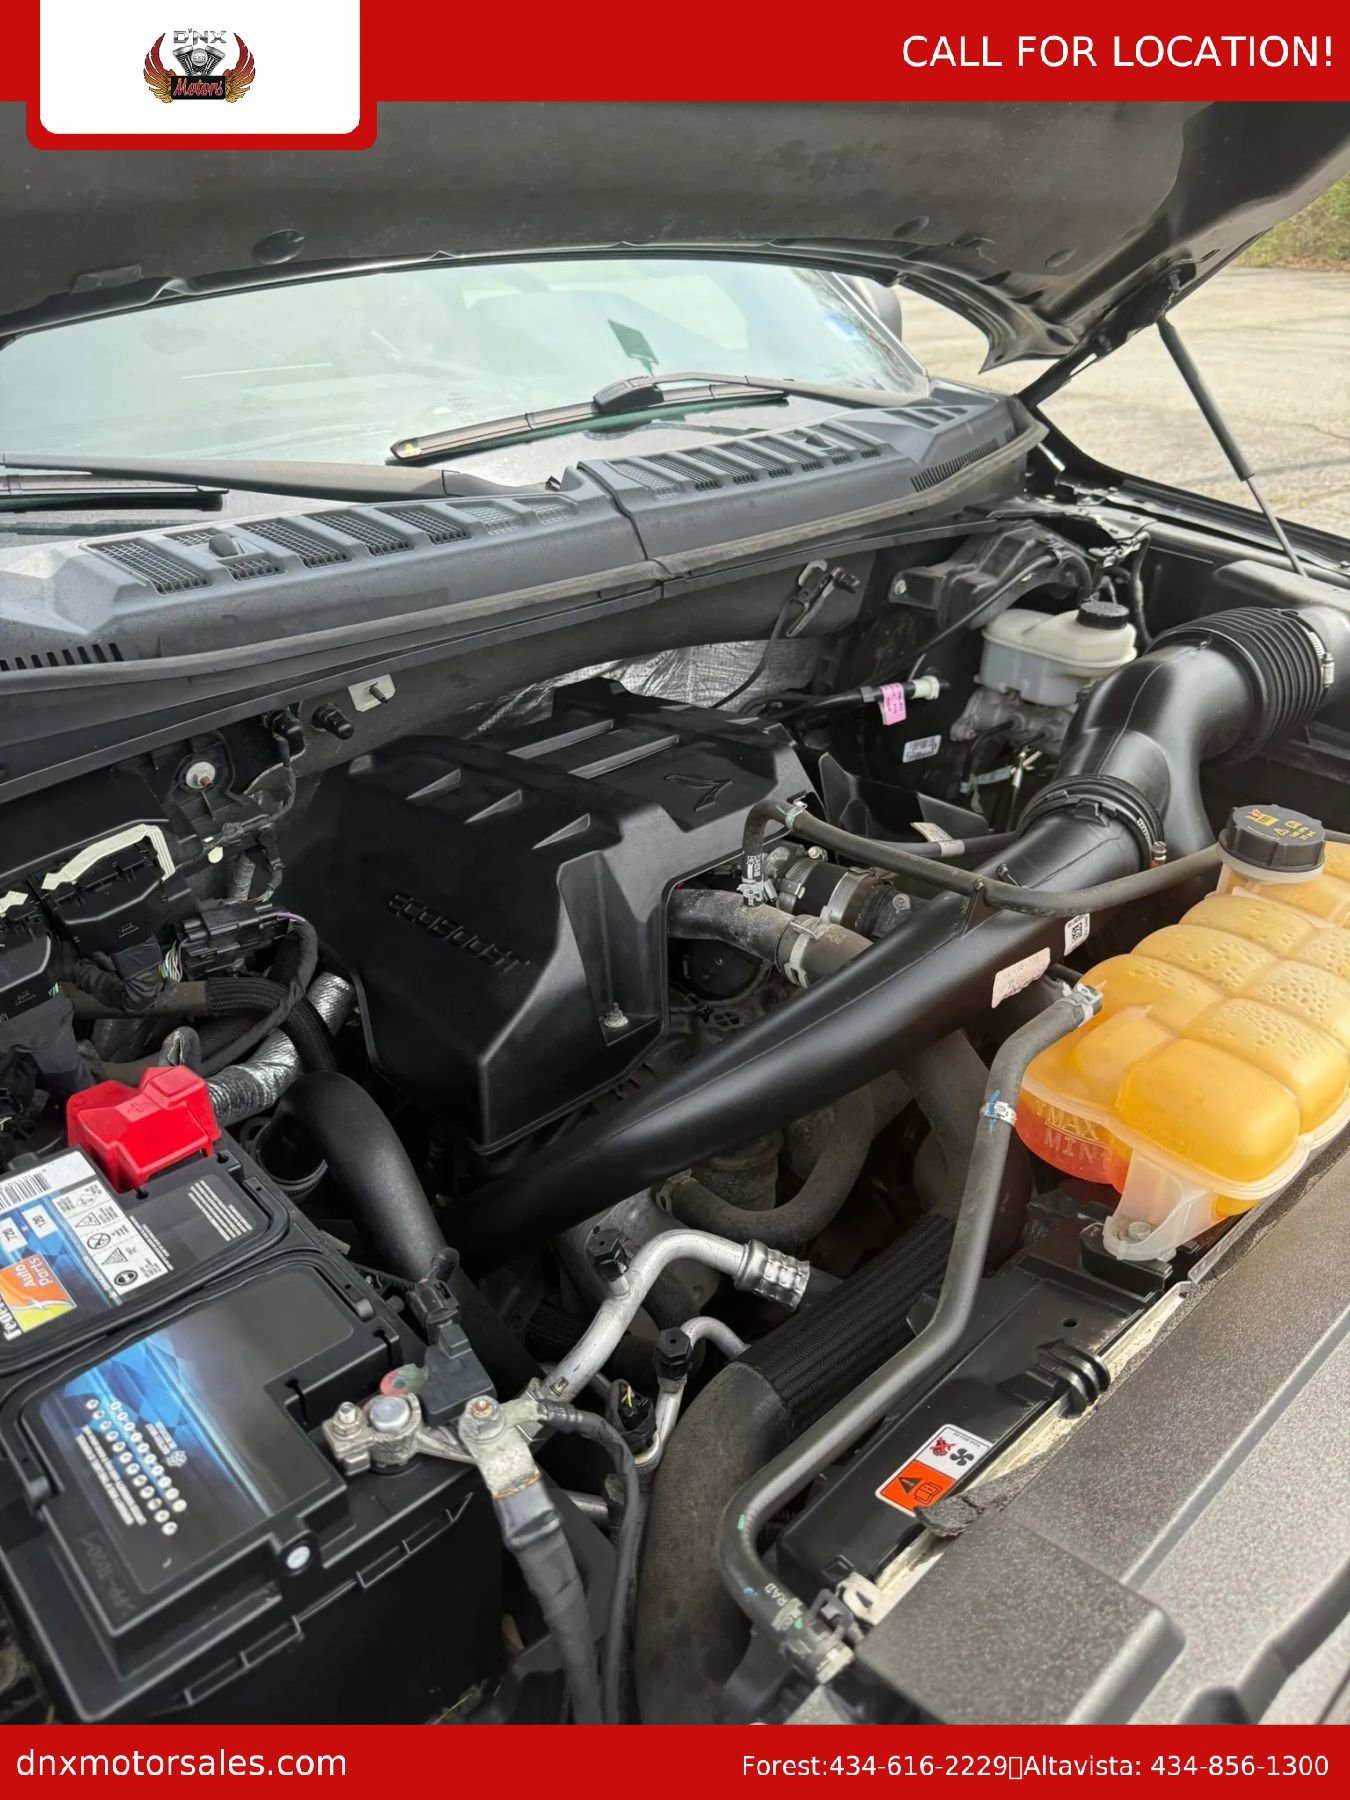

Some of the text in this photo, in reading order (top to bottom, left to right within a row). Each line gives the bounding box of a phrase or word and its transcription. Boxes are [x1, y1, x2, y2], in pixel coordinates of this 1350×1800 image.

[1046, 1104, 1100, 1140] MAX
[1044, 1128, 1098, 1163] MIN
[16, 1264, 37, 1287] Auto
[29, 1257, 54, 1286] Parts
[764, 1582, 788, 1607] RAD
